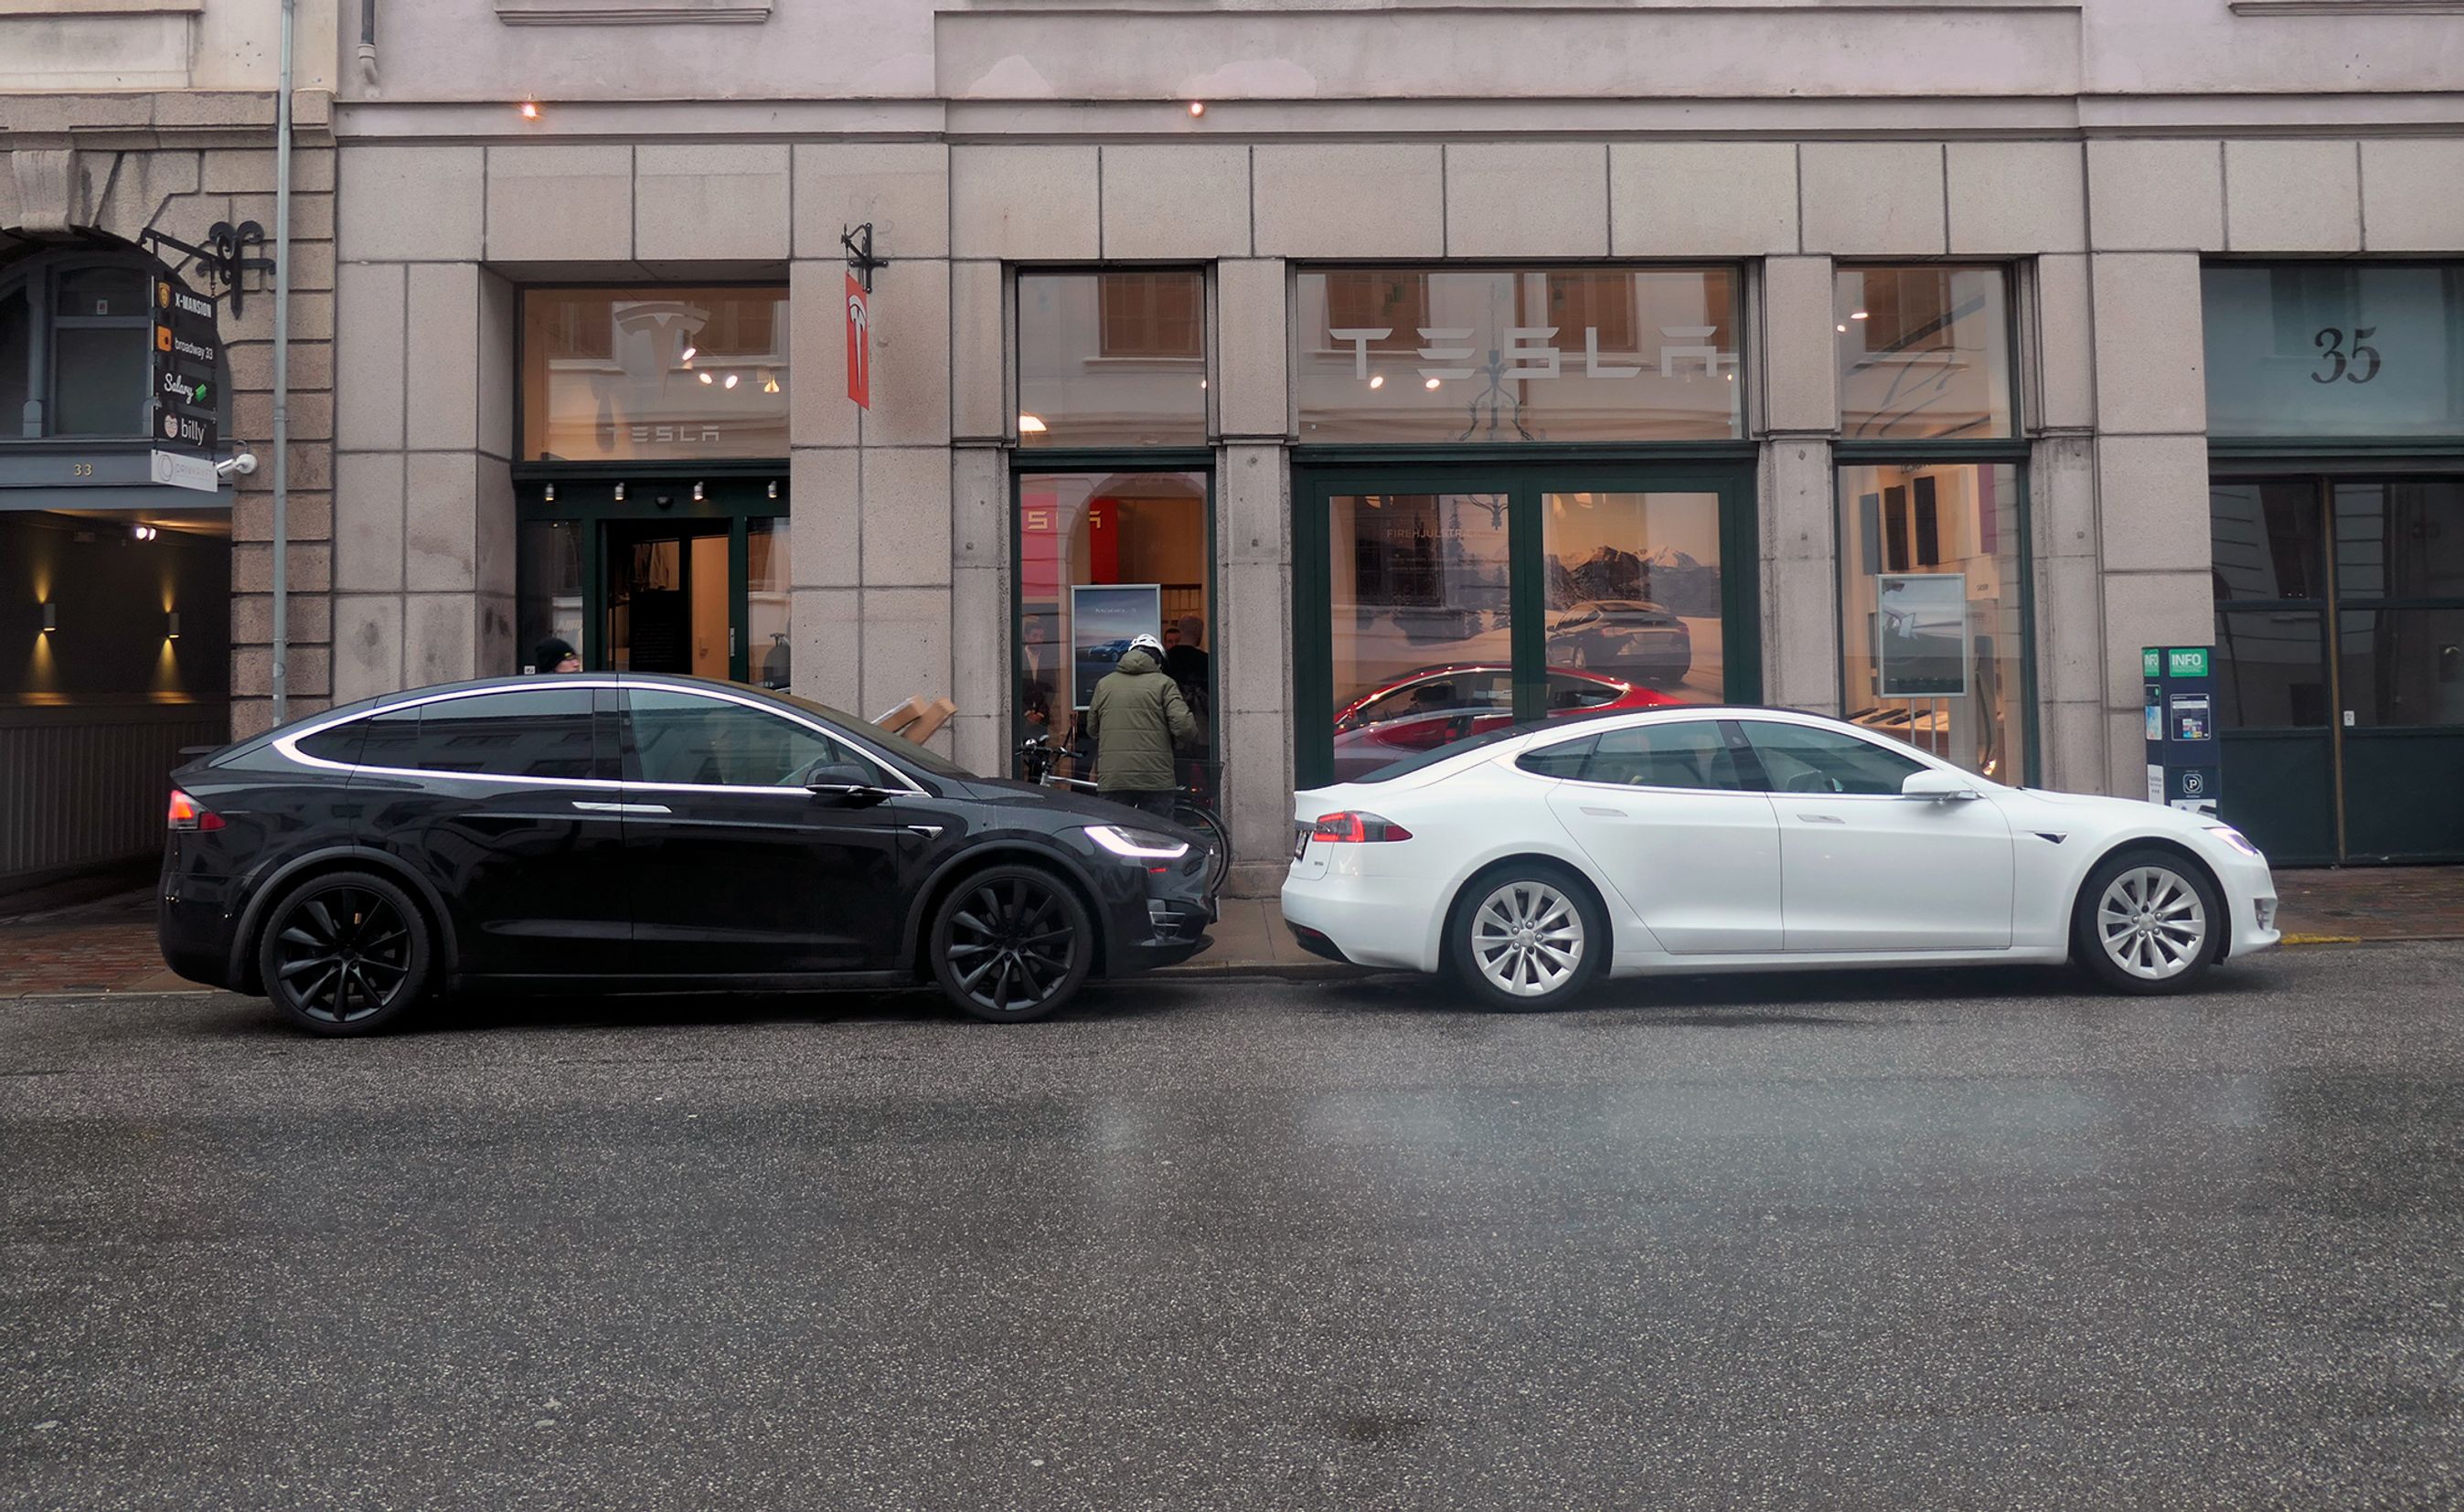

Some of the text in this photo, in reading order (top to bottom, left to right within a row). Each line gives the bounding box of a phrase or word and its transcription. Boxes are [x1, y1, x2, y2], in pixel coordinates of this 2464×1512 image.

[175, 293, 212, 318] X-MANSION
[175, 338, 213, 360] broadway 33
[1328, 325, 1718, 379] TESLA
[2310, 326, 2381, 384] 35
[164, 373, 194, 404] Salary
[181, 418, 205, 446] billy
[606, 425, 720, 442] TESLA
[73, 463, 92, 476] 33
[2144, 654, 2159, 665] INFO
[2171, 654, 2202, 665] INFO
